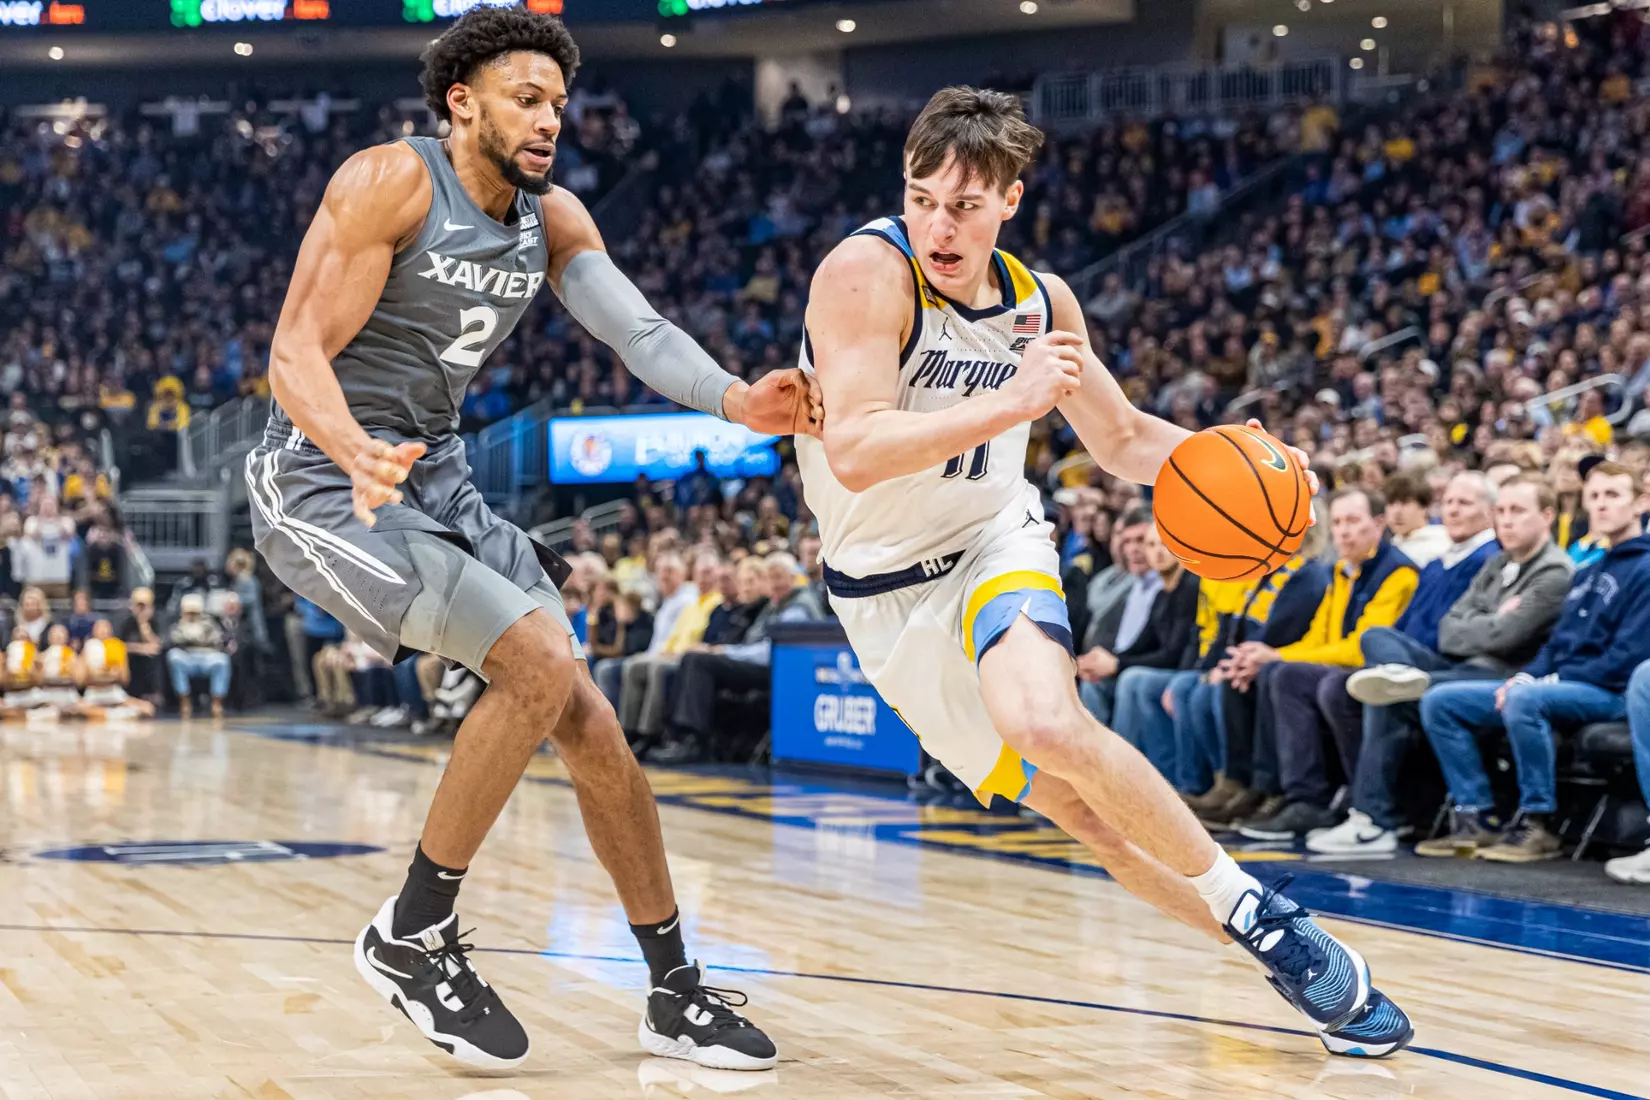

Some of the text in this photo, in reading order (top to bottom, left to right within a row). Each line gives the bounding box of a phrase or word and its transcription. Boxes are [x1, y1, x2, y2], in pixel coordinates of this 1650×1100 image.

[418, 251, 545, 299] XAVIER
[440, 306, 497, 368] 2
[814, 694, 877, 736] GRUBER
